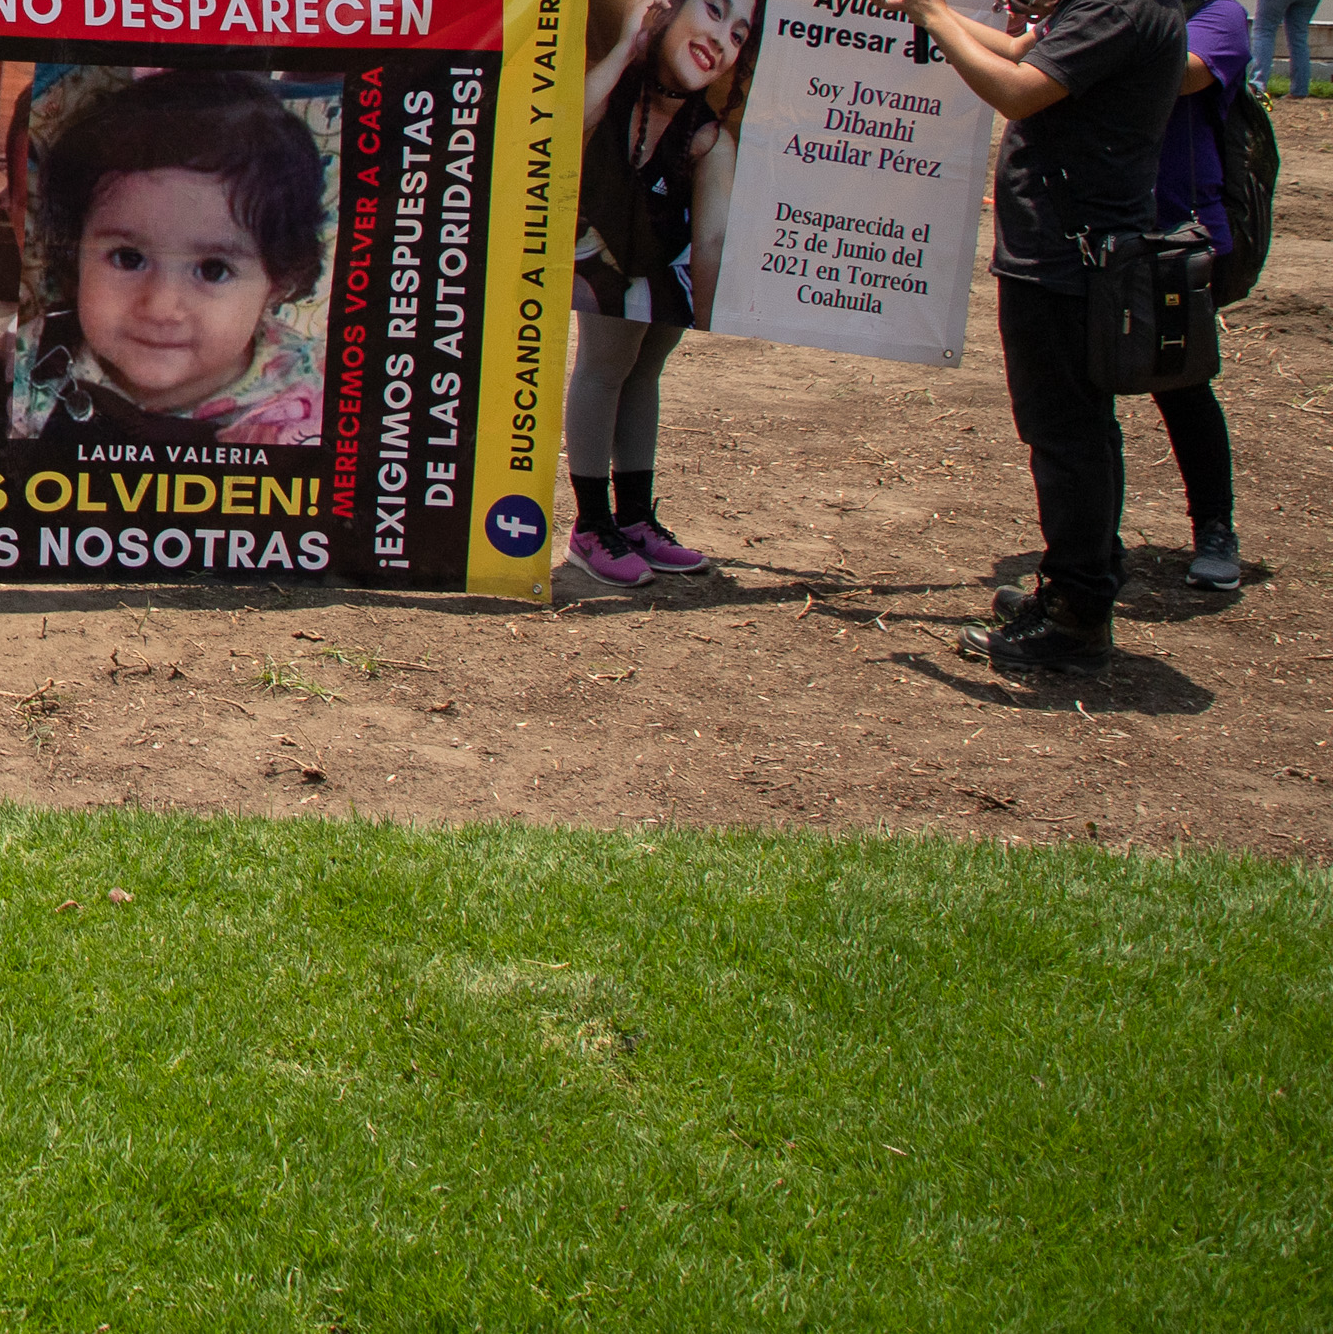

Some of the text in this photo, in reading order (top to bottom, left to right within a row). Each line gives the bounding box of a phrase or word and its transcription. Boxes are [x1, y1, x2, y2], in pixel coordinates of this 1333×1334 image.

[777, 18, 897, 54] regresar
[530, 104, 554, 125] Y
[807, 77, 942, 117] Soy Jovanna
[823, 107, 916, 143] Dibanhi
[783, 134, 942, 179] Aguilar Pérez
[523, 136, 552, 255] LILIANA
[775, 202, 931, 243] Desaparecida el
[773, 228, 923, 268] 25 de Junio del
[333, 66, 383, 518] MERECEMOS VOLVER A CASA
[425, 67, 483, 507] DE LAS AUTORIDADES!
[521, 267, 546, 288] A
[761, 252, 929, 296] 2021 en Torreón
[797, 284, 883, 315] Coahuila
[374, 90, 434, 569] ¡EXIGIMOS RESPUESTAS
[509, 298, 544, 472] BUSCANDO
[78, 444, 269, 466] LAURA VALERIA
[25, 470, 320, 517] OLVIDEN!
[39, 526, 329, 571] NOSOTRAS
